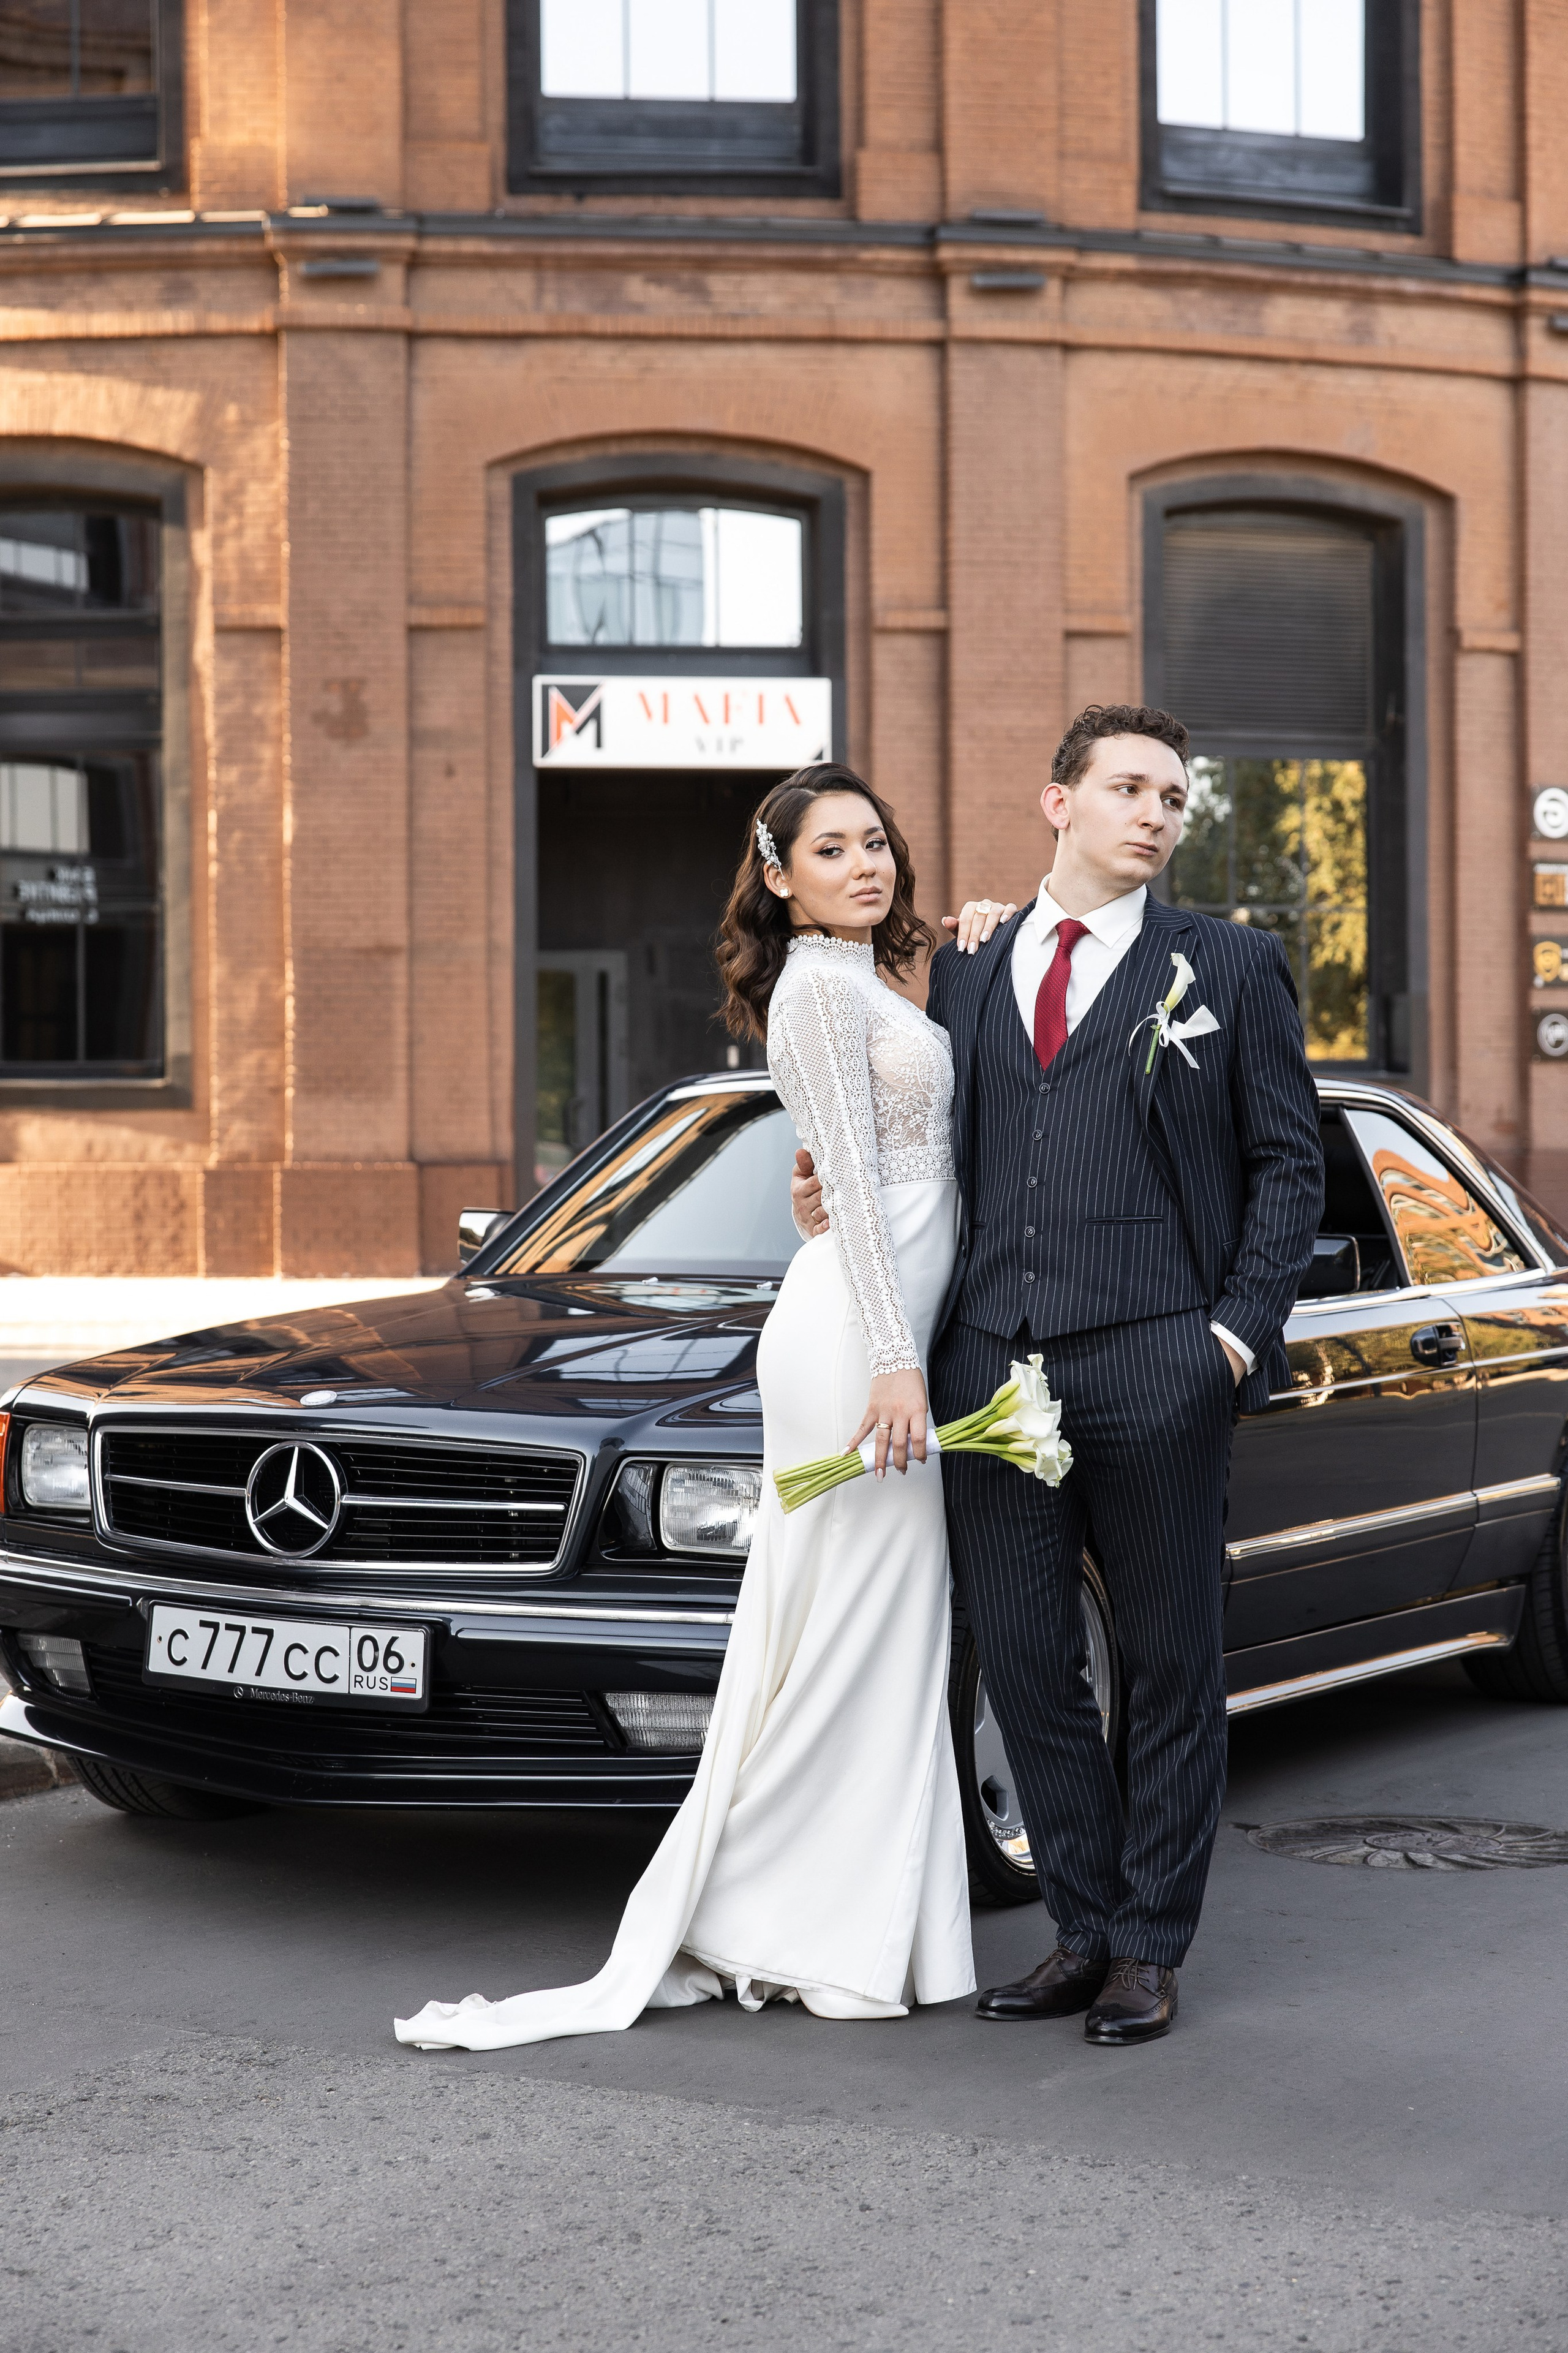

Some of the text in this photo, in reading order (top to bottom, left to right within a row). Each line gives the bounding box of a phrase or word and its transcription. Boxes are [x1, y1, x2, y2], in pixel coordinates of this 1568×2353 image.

[357, 1634, 405, 1675] 06
[353, 1675, 389, 1691] RUS
[250, 1687, 314, 1704] Mercedes-Benz
